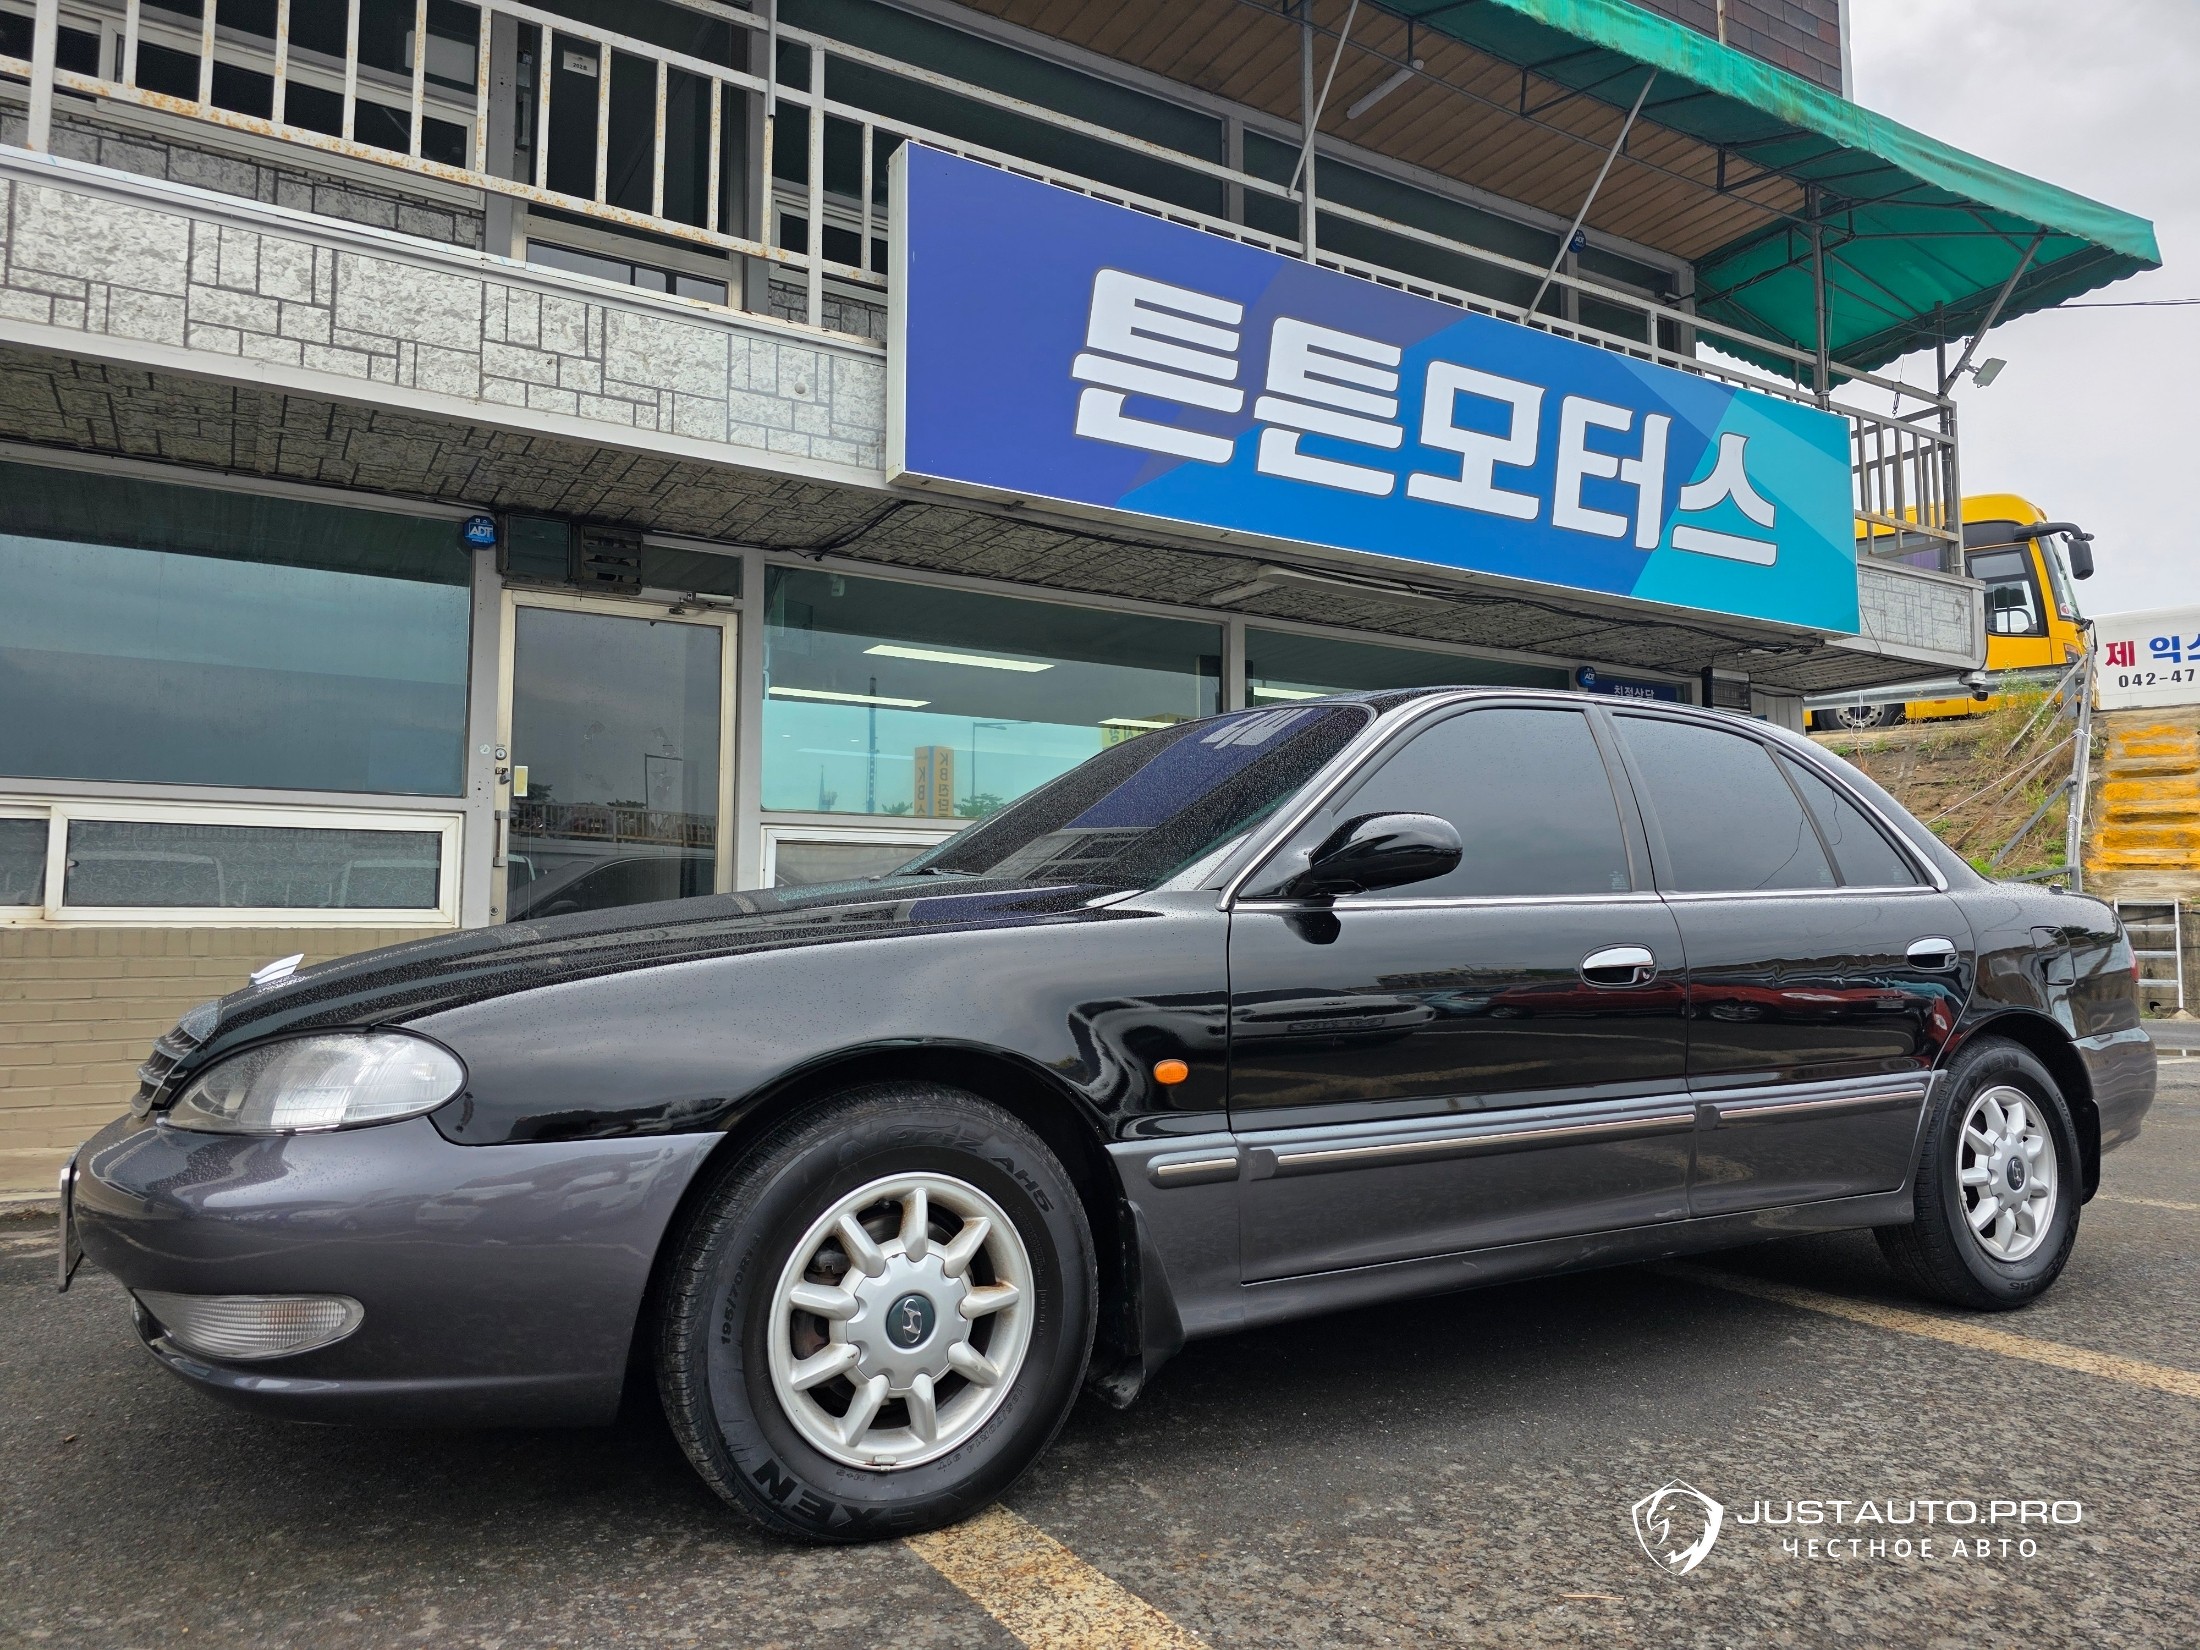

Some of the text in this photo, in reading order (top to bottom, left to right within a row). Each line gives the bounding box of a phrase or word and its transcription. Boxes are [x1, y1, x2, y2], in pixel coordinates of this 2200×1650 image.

[1071, 268, 1779, 566] 튼튼모터스
[469, 525, 494, 538] ADT
[1584, 673, 1595, 681] ADT
[2118, 668, 2195, 688] 042-47
[990, 1155, 1055, 1213] AH5
